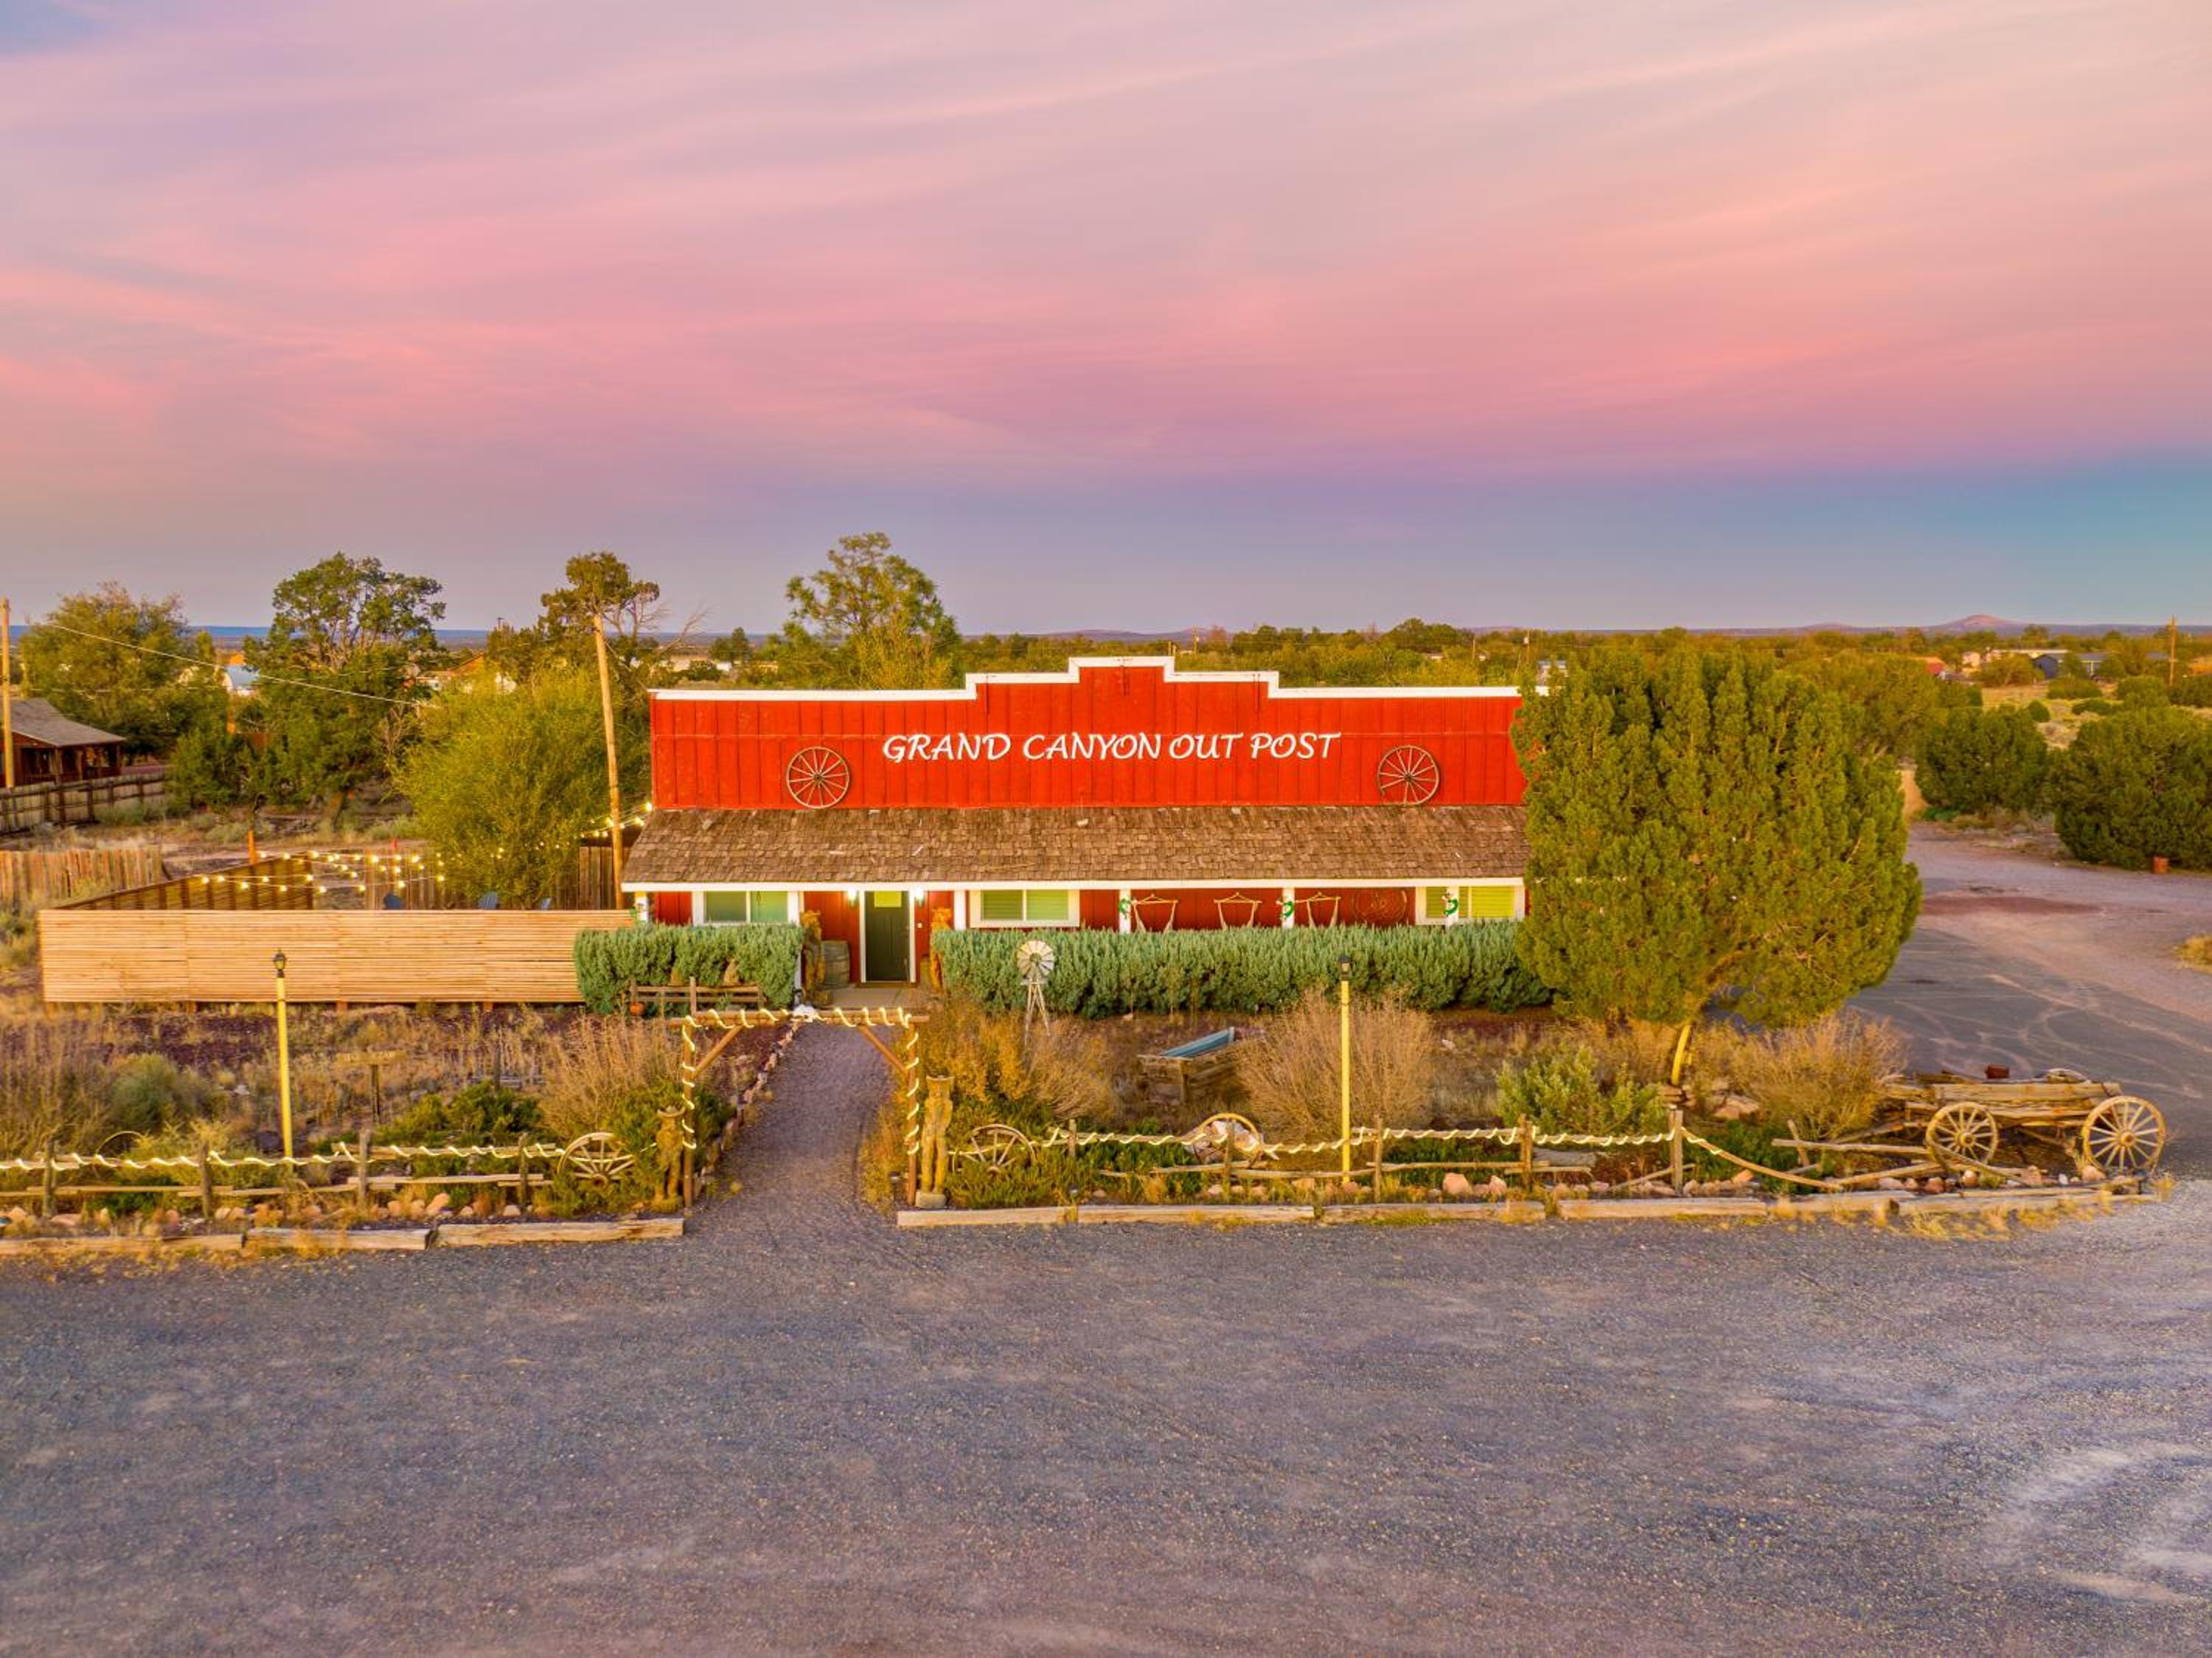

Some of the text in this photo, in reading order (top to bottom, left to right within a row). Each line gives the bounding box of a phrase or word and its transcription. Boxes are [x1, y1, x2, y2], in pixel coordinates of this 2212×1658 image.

[882, 732, 1342, 763] GRAND CANYON OUT POST
